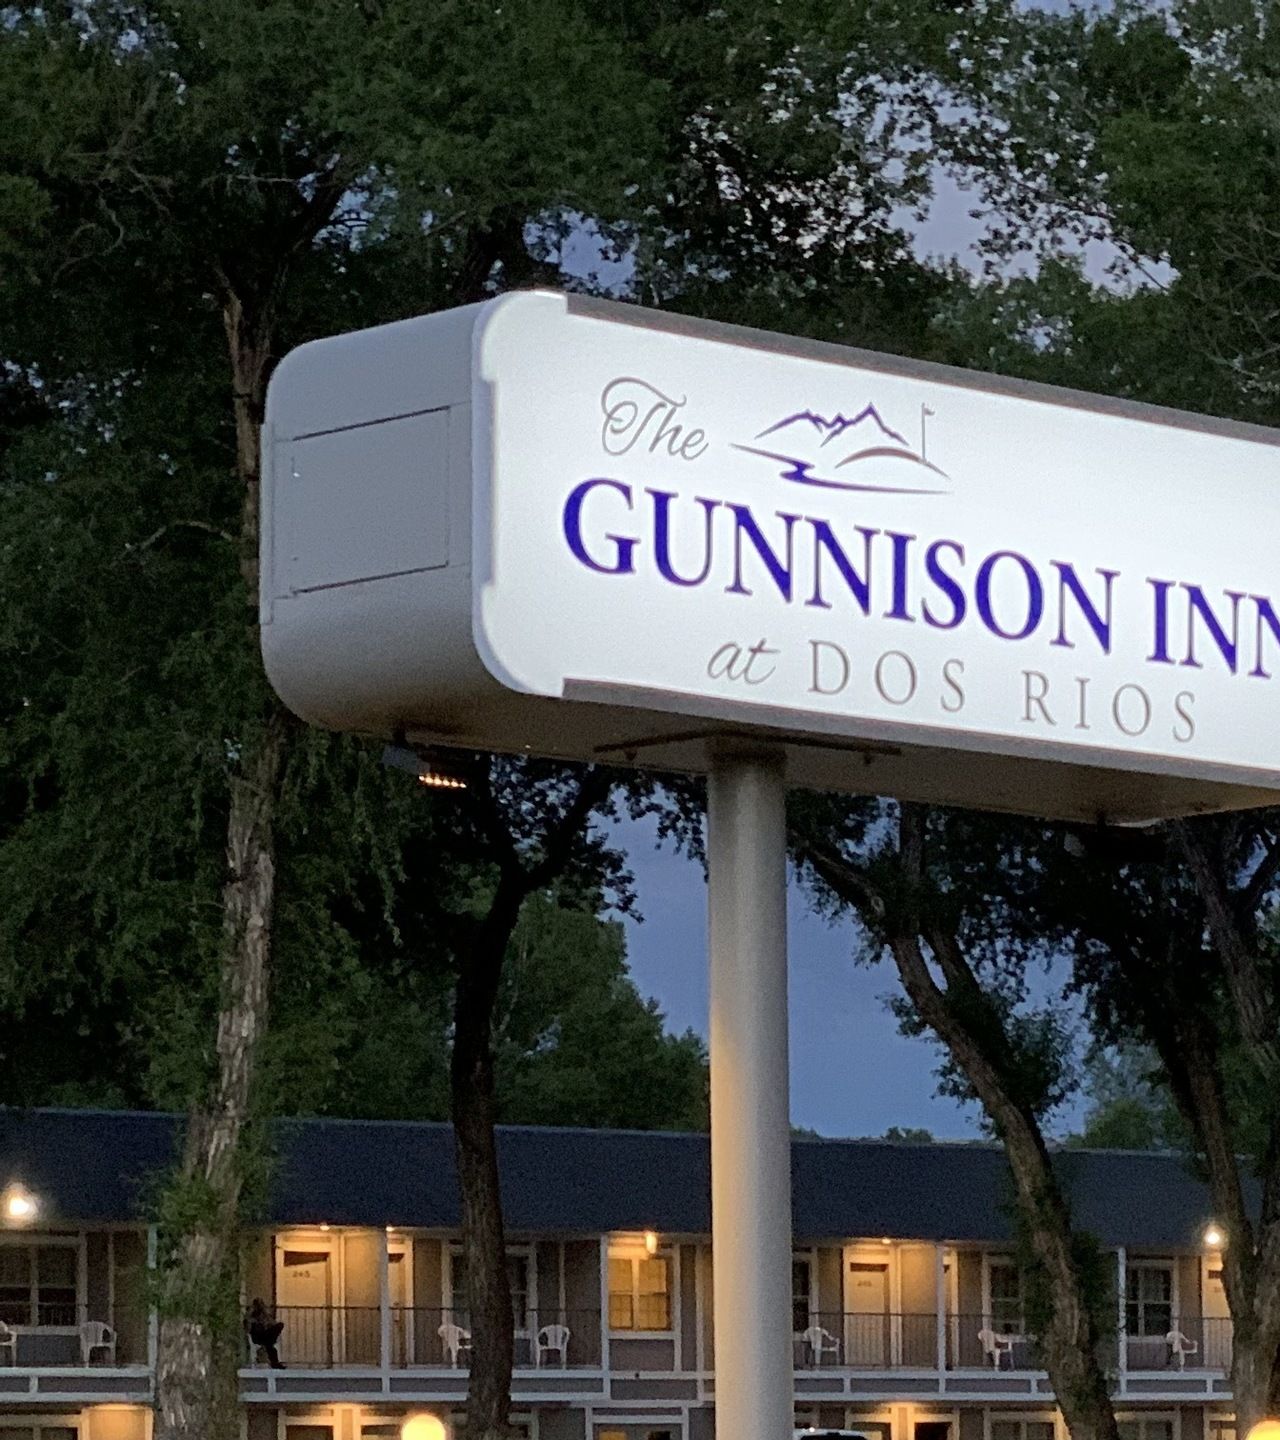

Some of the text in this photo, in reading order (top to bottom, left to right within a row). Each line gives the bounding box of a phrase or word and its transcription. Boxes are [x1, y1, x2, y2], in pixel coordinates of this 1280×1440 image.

[600, 376, 711, 462] The
[562, 477, 1121, 656] GUNNISON
[707, 638, 1196, 743] at DOS RIOS
